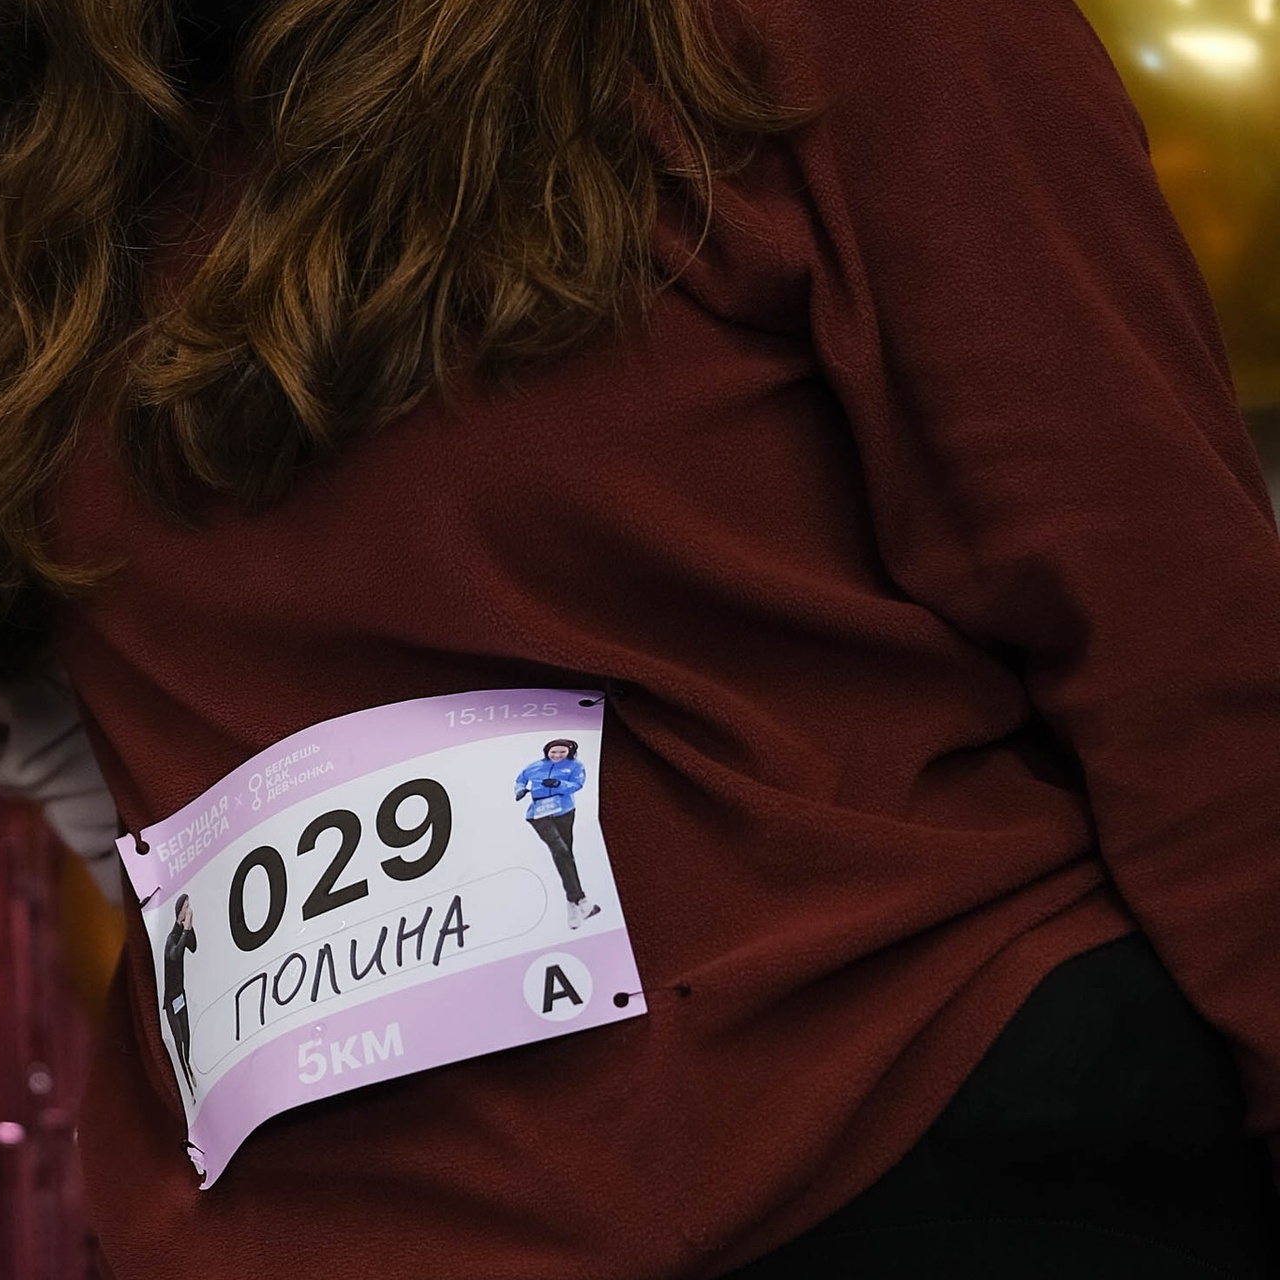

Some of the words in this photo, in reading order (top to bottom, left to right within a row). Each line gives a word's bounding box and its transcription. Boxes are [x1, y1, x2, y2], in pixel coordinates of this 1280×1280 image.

[445, 702, 559, 729] 15.11.25
[265, 743, 321, 777] БЕГАЕШЬ
[266, 767, 291, 789] КАК
[267, 760, 335, 802] ДЕВЧОНКА
[157, 795, 229, 863] БЕГУЩАЯ
[167, 816, 231, 879] НЕВЕСТА
[228, 777, 453, 952] 029
[235, 894, 470, 1041] ПОЛИНА
